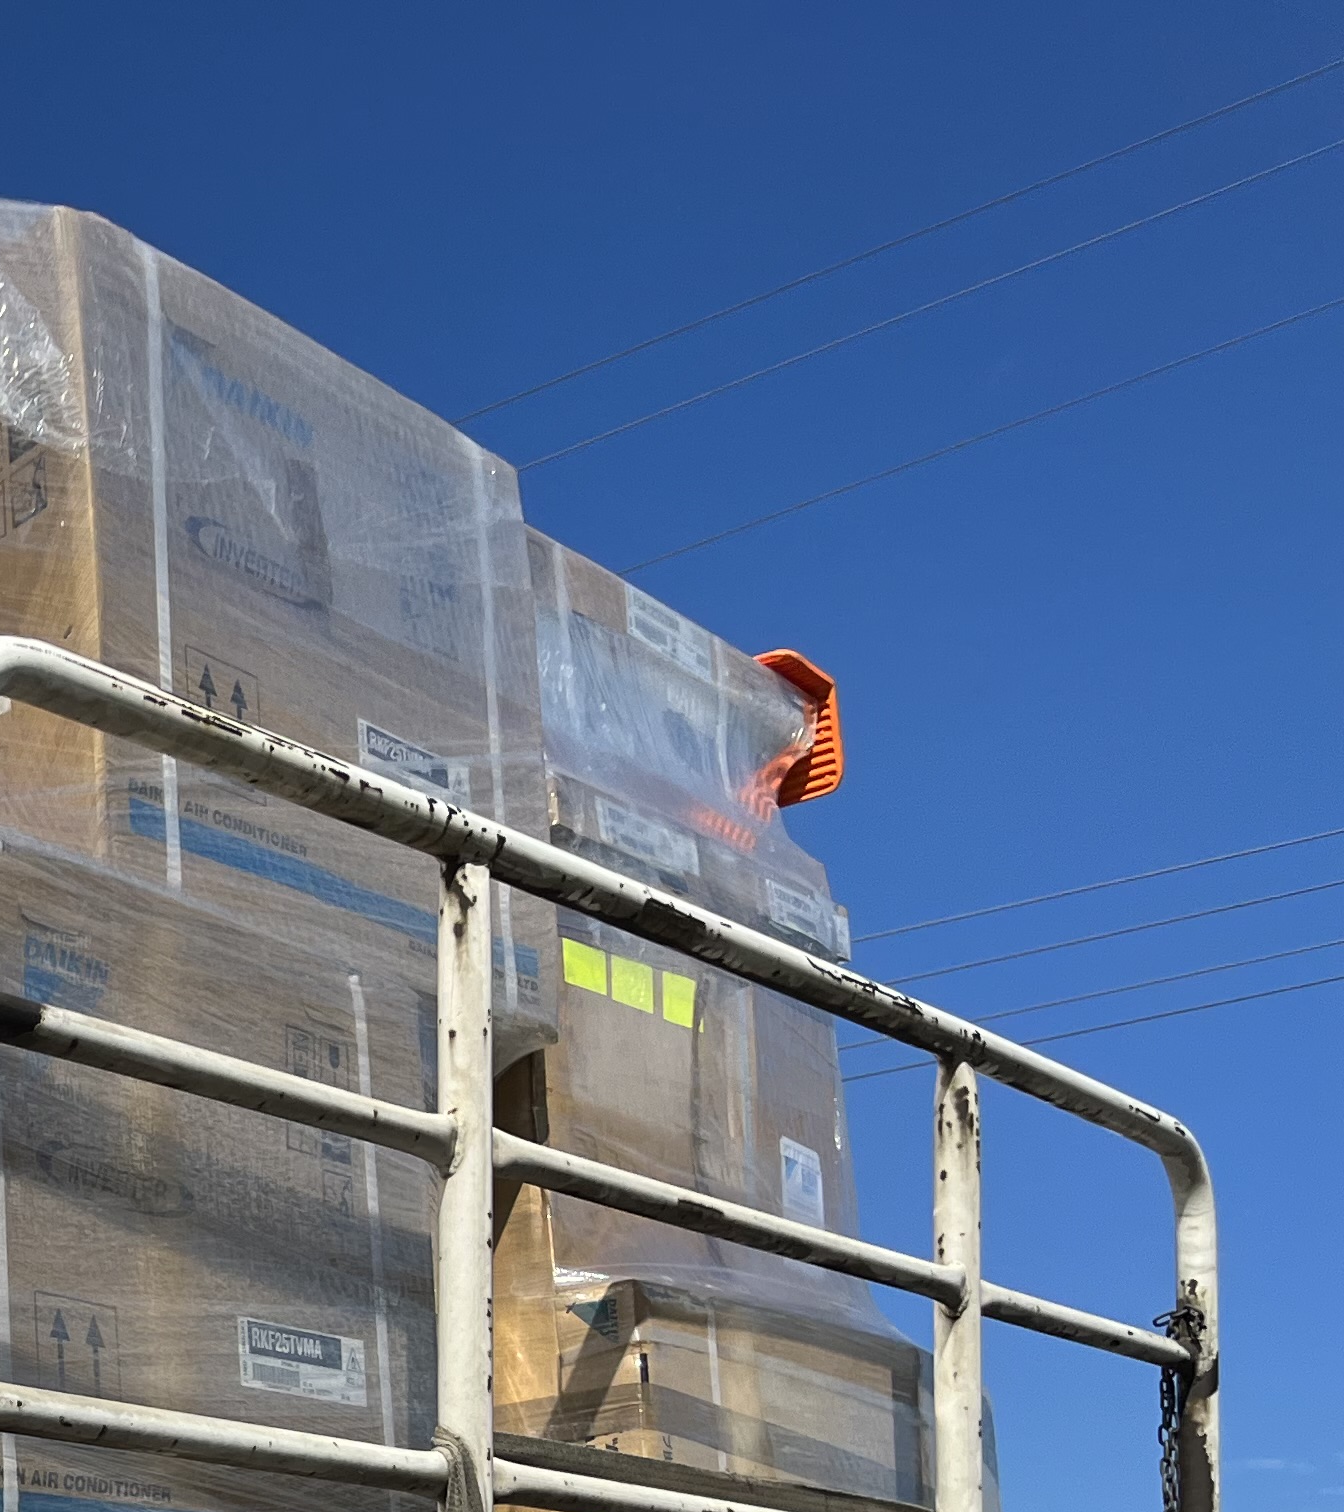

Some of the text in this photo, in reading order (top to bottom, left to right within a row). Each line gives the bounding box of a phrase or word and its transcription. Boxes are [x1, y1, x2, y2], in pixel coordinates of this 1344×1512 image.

[183, 799, 209, 818] AIR
[212, 809, 308, 858] CONDITIONER
[252, 1327, 323, 1360] RKF25TVMA
[31, 1470, 59, 1490] AIR
[63, 1474, 172, 1502] CONDITIONER
